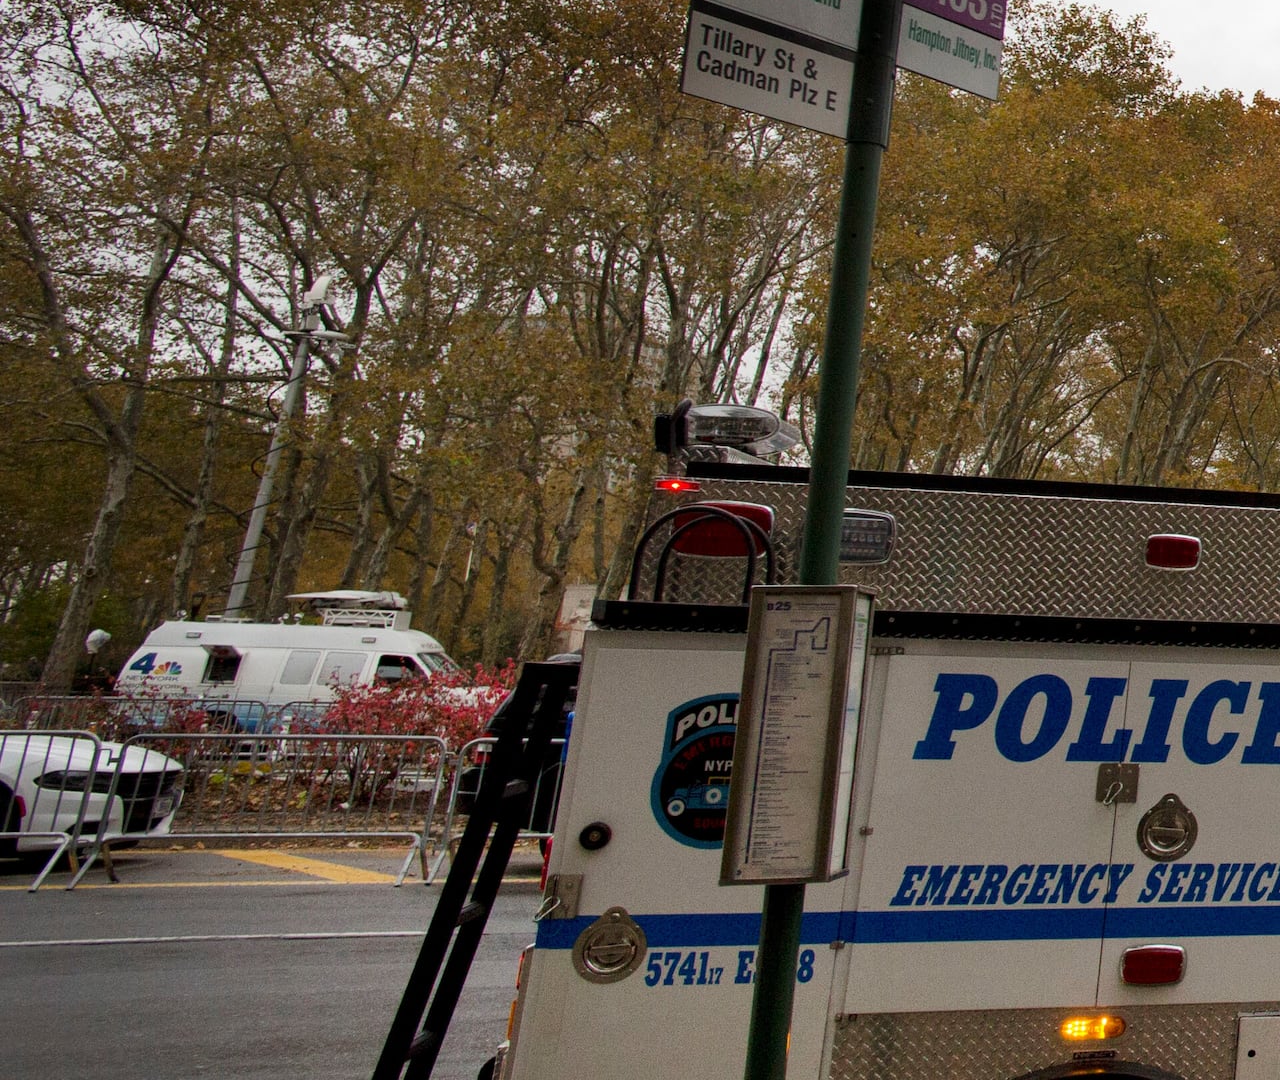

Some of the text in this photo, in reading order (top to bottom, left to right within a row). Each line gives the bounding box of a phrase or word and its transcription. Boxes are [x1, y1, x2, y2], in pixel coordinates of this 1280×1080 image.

[701, 23, 818, 80] Tillary St &
[908, 19, 952, 53] Hampton
[984, 48, 999, 72] Inc.
[696, 51, 837, 112] Cadman Plz E
[129, 652, 158, 674] 4
[675, 702, 740, 742] POLI
[673, 735, 735, 770] EMERG
[704, 760, 733, 772] NYP
[889, 864, 1134, 906] EMERGENCY
